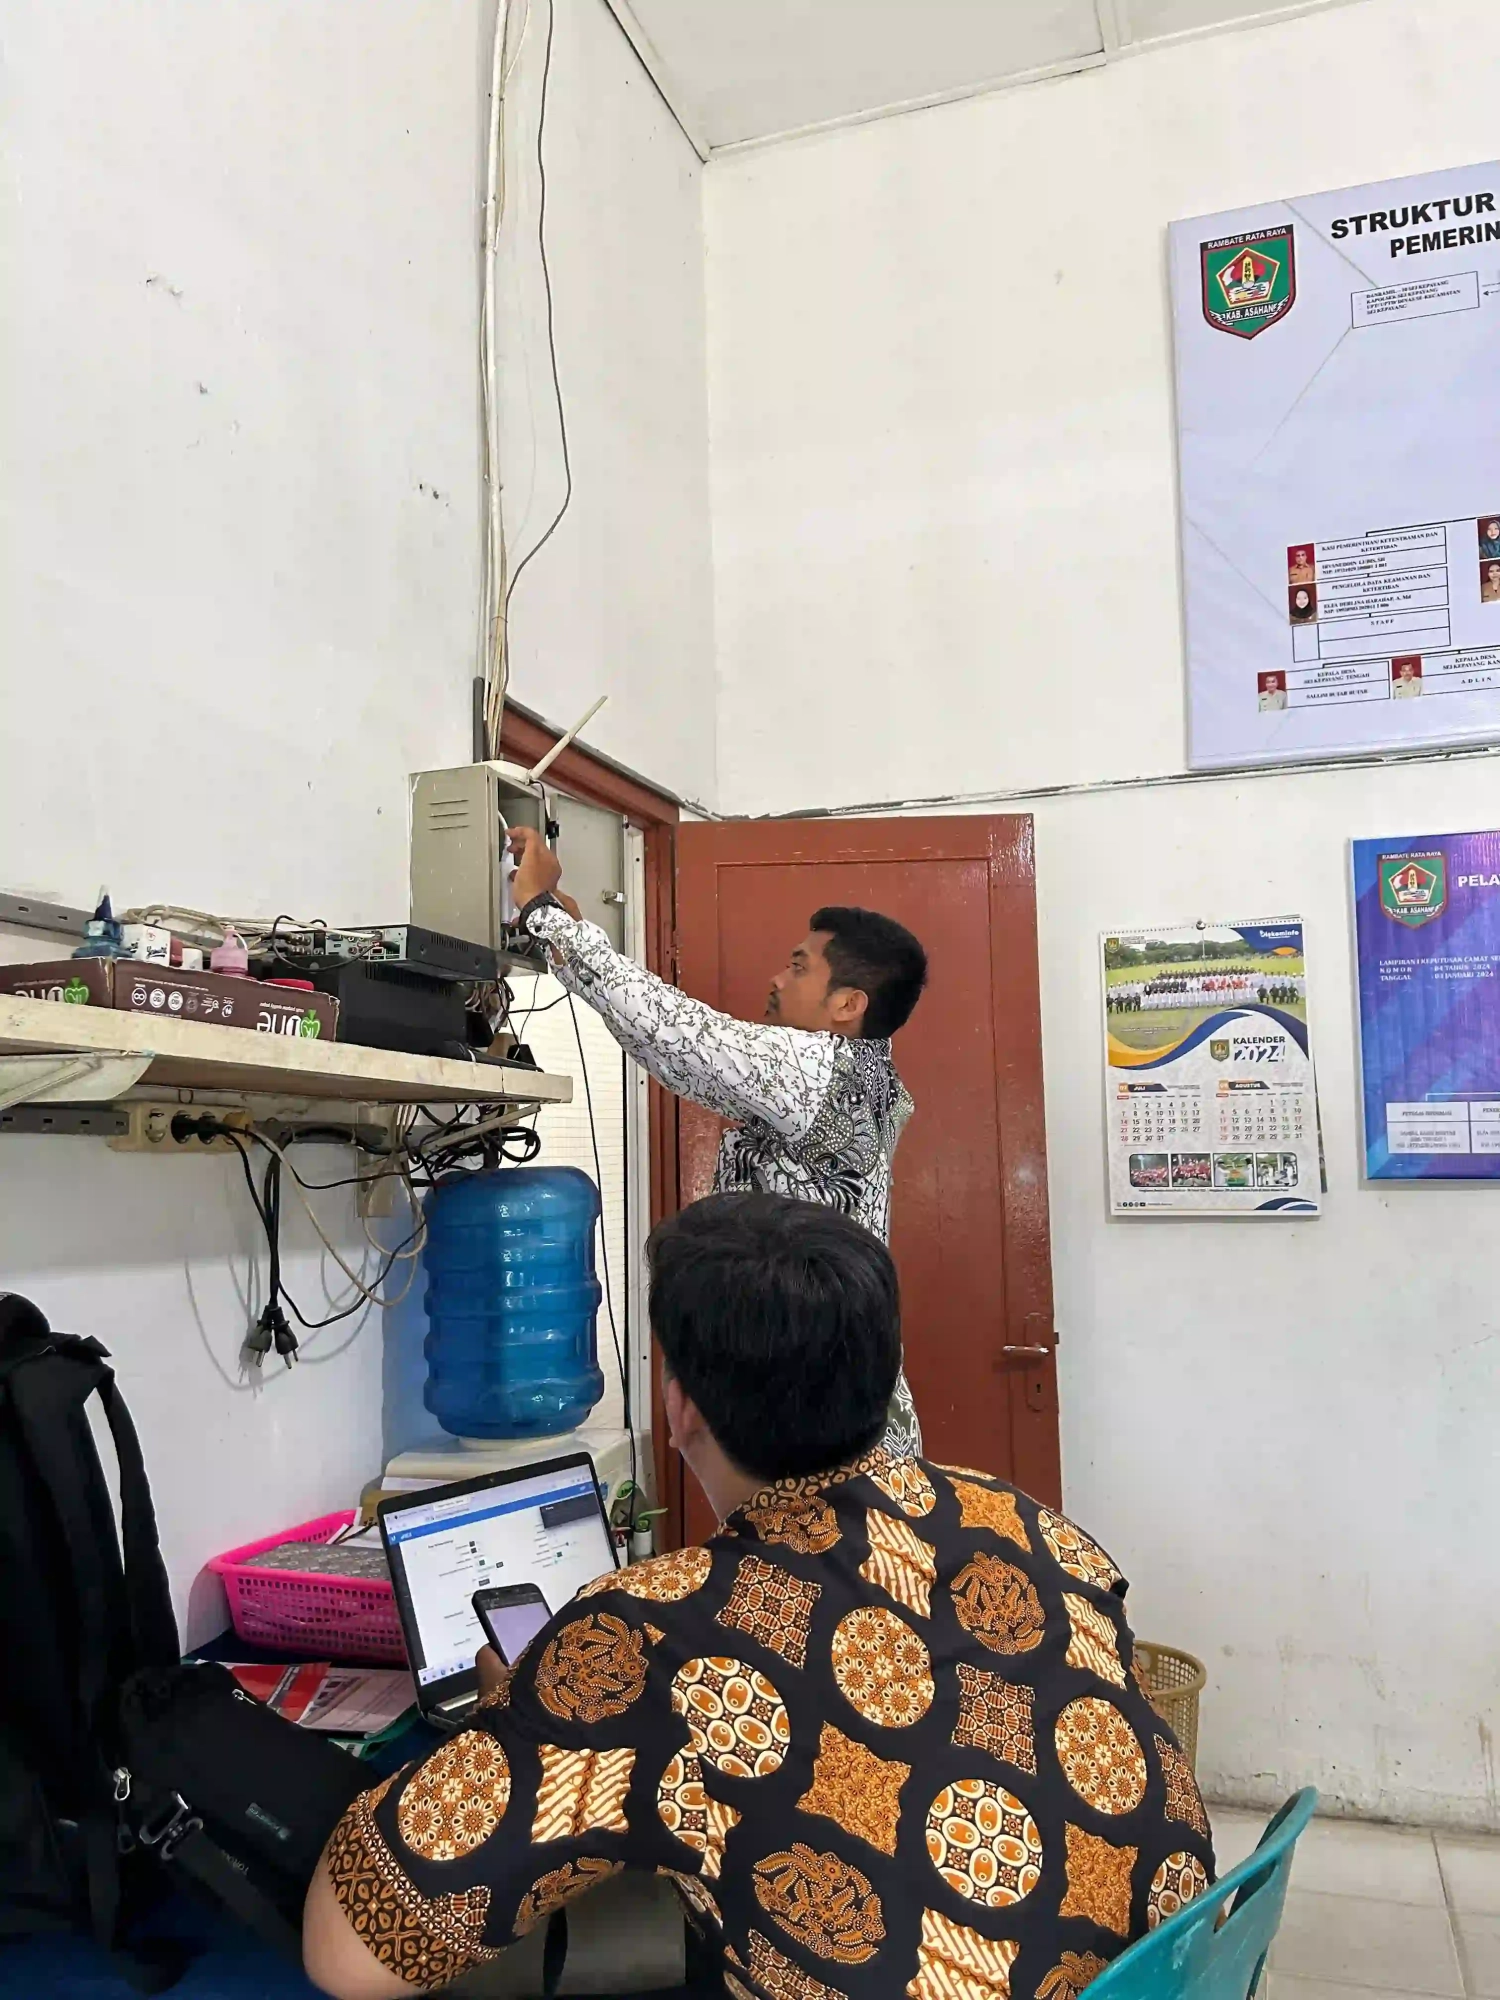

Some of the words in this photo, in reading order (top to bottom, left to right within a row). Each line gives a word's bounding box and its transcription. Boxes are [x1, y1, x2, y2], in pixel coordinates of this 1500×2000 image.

[1331, 192, 1496, 239] STRUKTUR
[1207, 235, 1244, 249] RAMBATE
[1245, 231, 1265, 242] RATA
[1266, 227, 1287, 237] RAYA
[1390, 221, 1500, 258] PEMERIN
[1226, 309, 1243, 320] KAB.
[1244, 304, 1274, 317] ASAHAN
[1458, 873, 1500, 888] PELA
[1233, 1035, 1286, 1045] KALENDER
[1234, 1045, 1286, 1063] 2024
